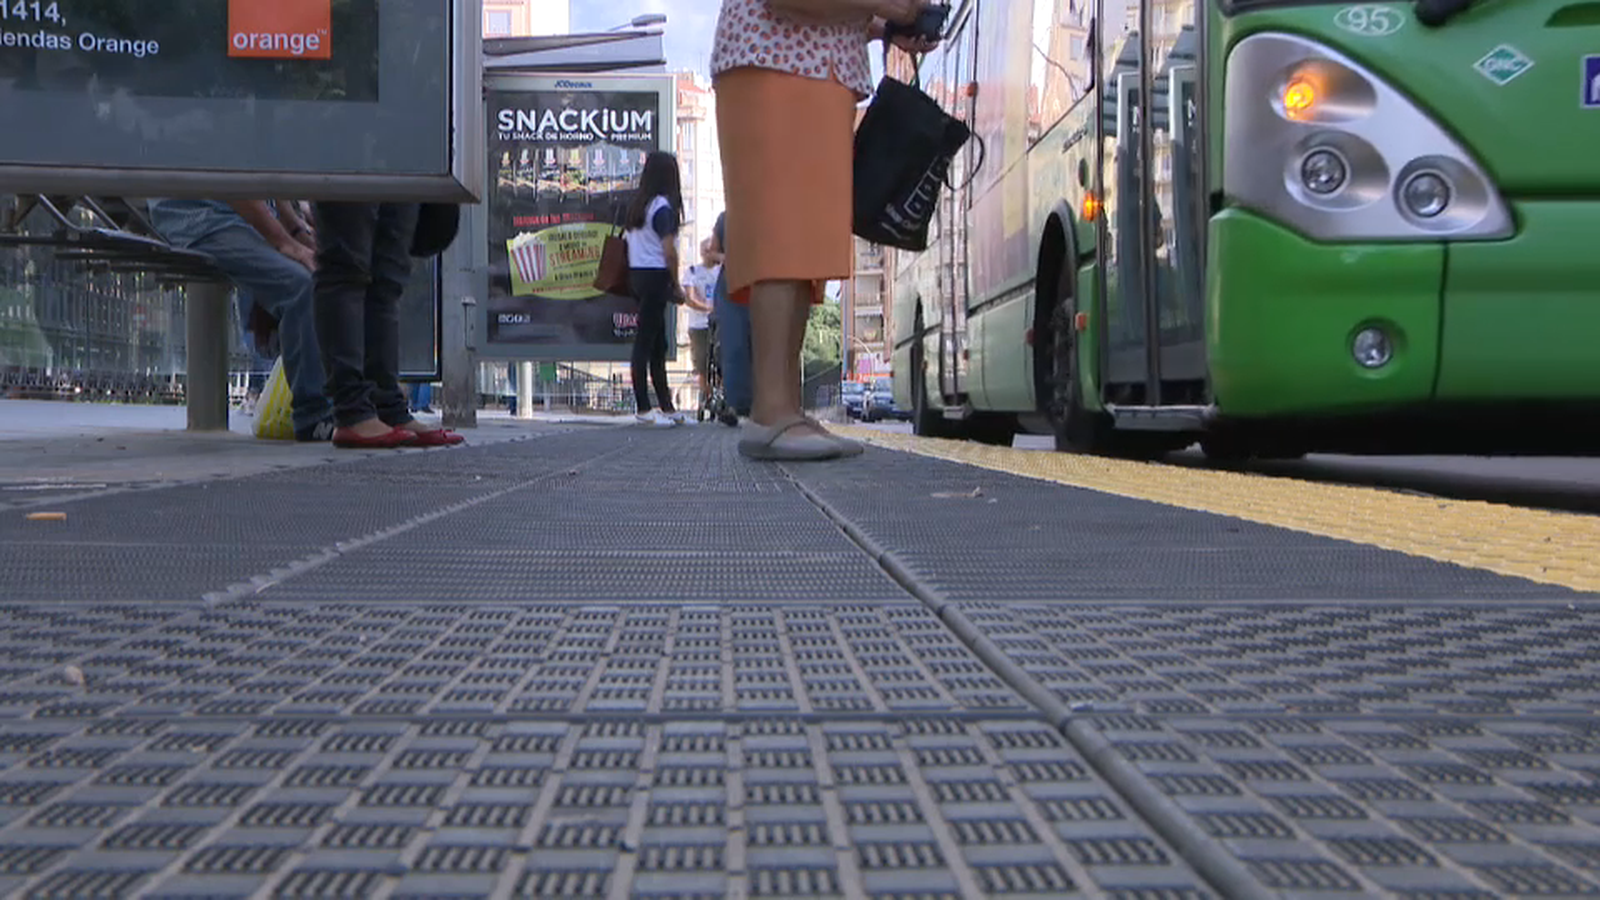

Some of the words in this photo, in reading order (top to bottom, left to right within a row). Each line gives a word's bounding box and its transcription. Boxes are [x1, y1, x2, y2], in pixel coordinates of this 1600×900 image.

[1348, 6, 1389, 32] 95
[78, 32, 159, 57] Orange
[513, 132, 543, 140] SNACK
